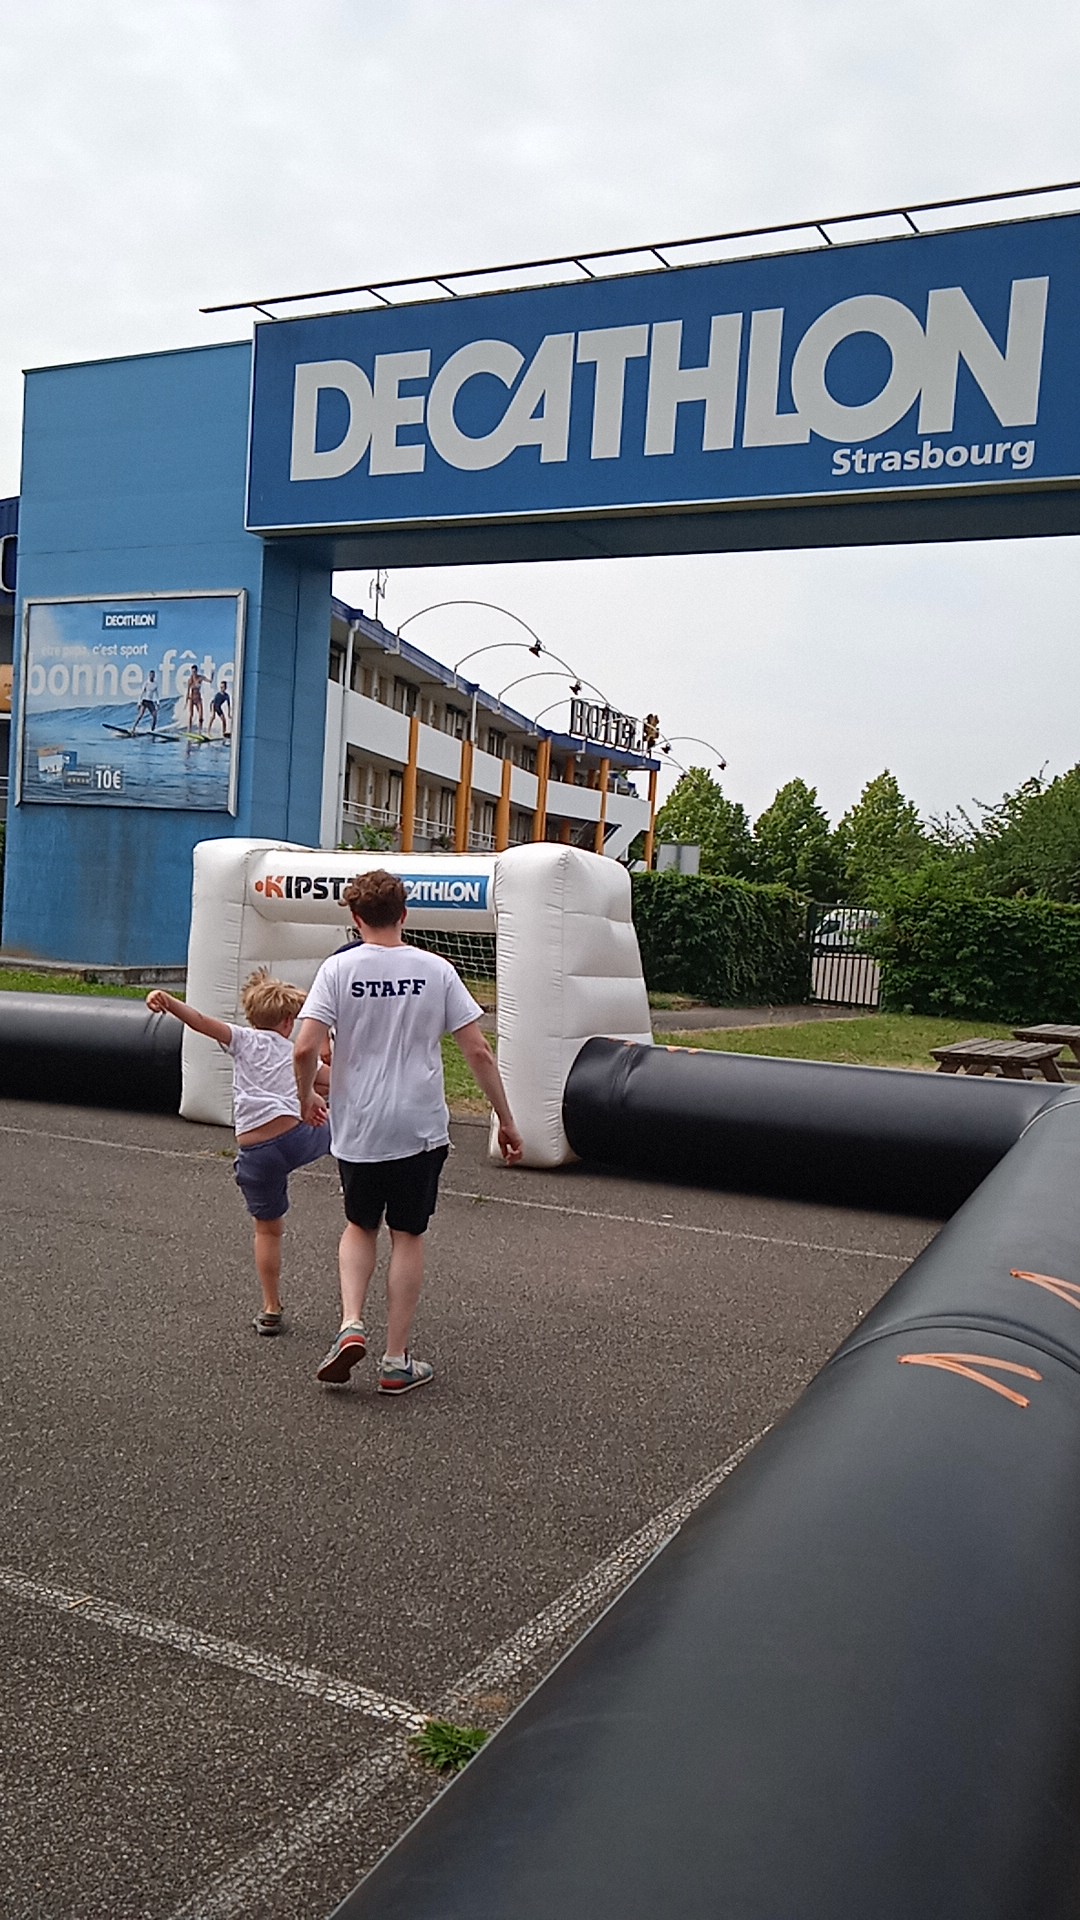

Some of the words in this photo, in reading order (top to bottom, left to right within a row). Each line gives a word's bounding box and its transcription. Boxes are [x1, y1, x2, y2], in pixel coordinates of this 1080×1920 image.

[290, 276, 1049, 482] DECATHLON
[831, 438, 1036, 476] Strasbourg
[105, 613, 155, 627] DECATHLON
[92, 644, 117, 656] c'est
[120, 643, 149, 659] sport
[27, 652, 144, 697] bonne
[570, 699, 642, 751] HOTEL
[95, 769, 122, 789] 10€
[265, 875, 356, 900] KIPST
[403, 880, 480, 902] CATHLON
[351, 979, 426, 998] STAFF
